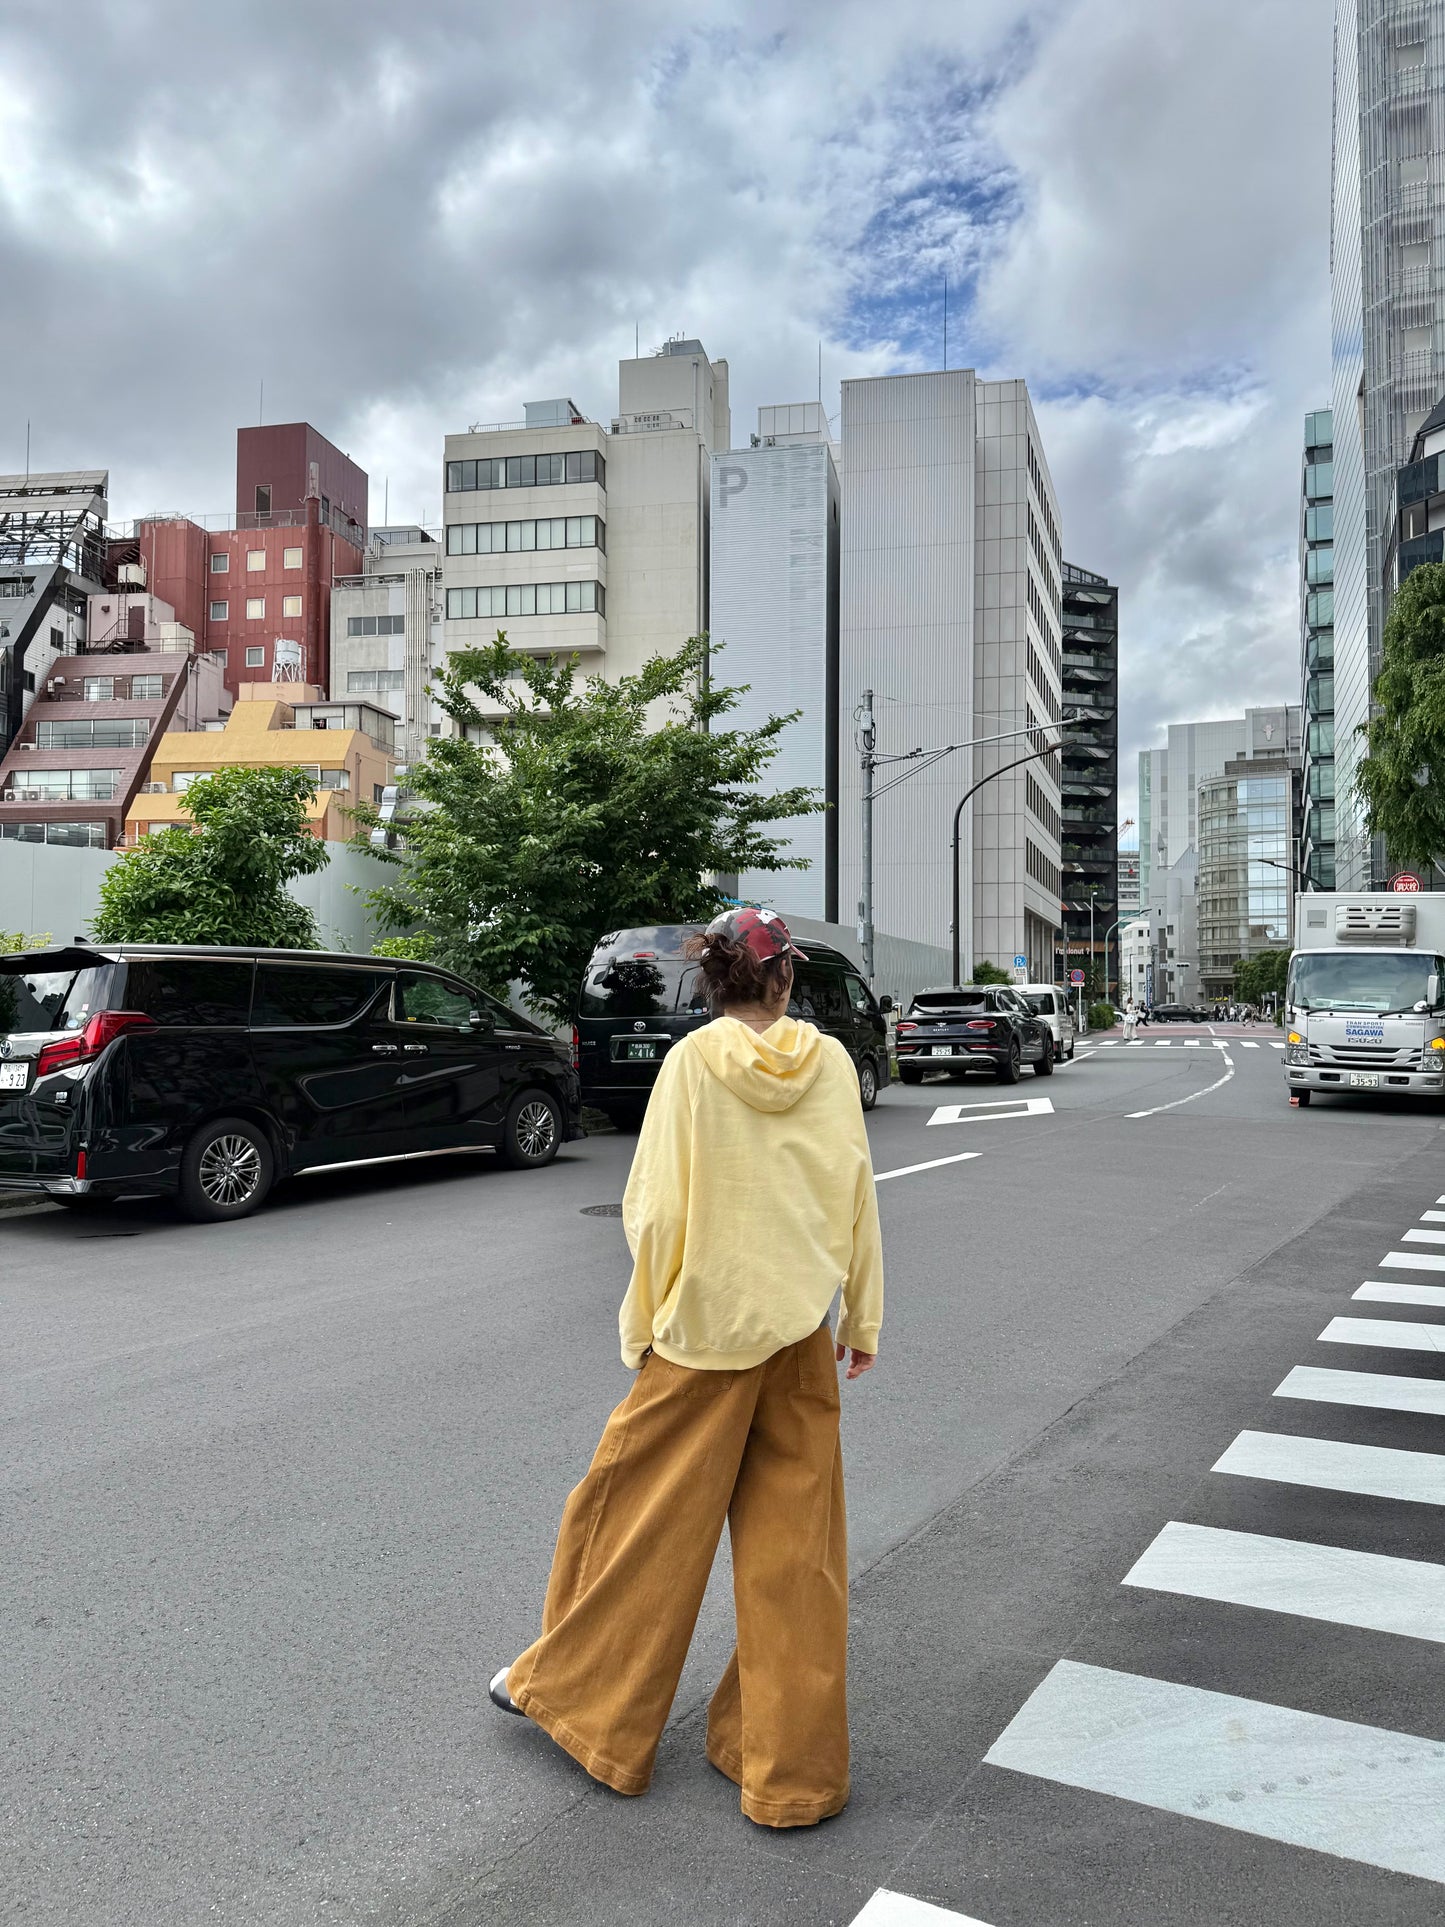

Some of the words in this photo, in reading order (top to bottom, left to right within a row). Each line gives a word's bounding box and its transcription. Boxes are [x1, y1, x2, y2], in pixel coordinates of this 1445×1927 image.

[719, 466, 748, 508] P
[1396, 882, 1417, 891] 消火栓
[1345, 1028, 1384, 1037] SAGAWA
